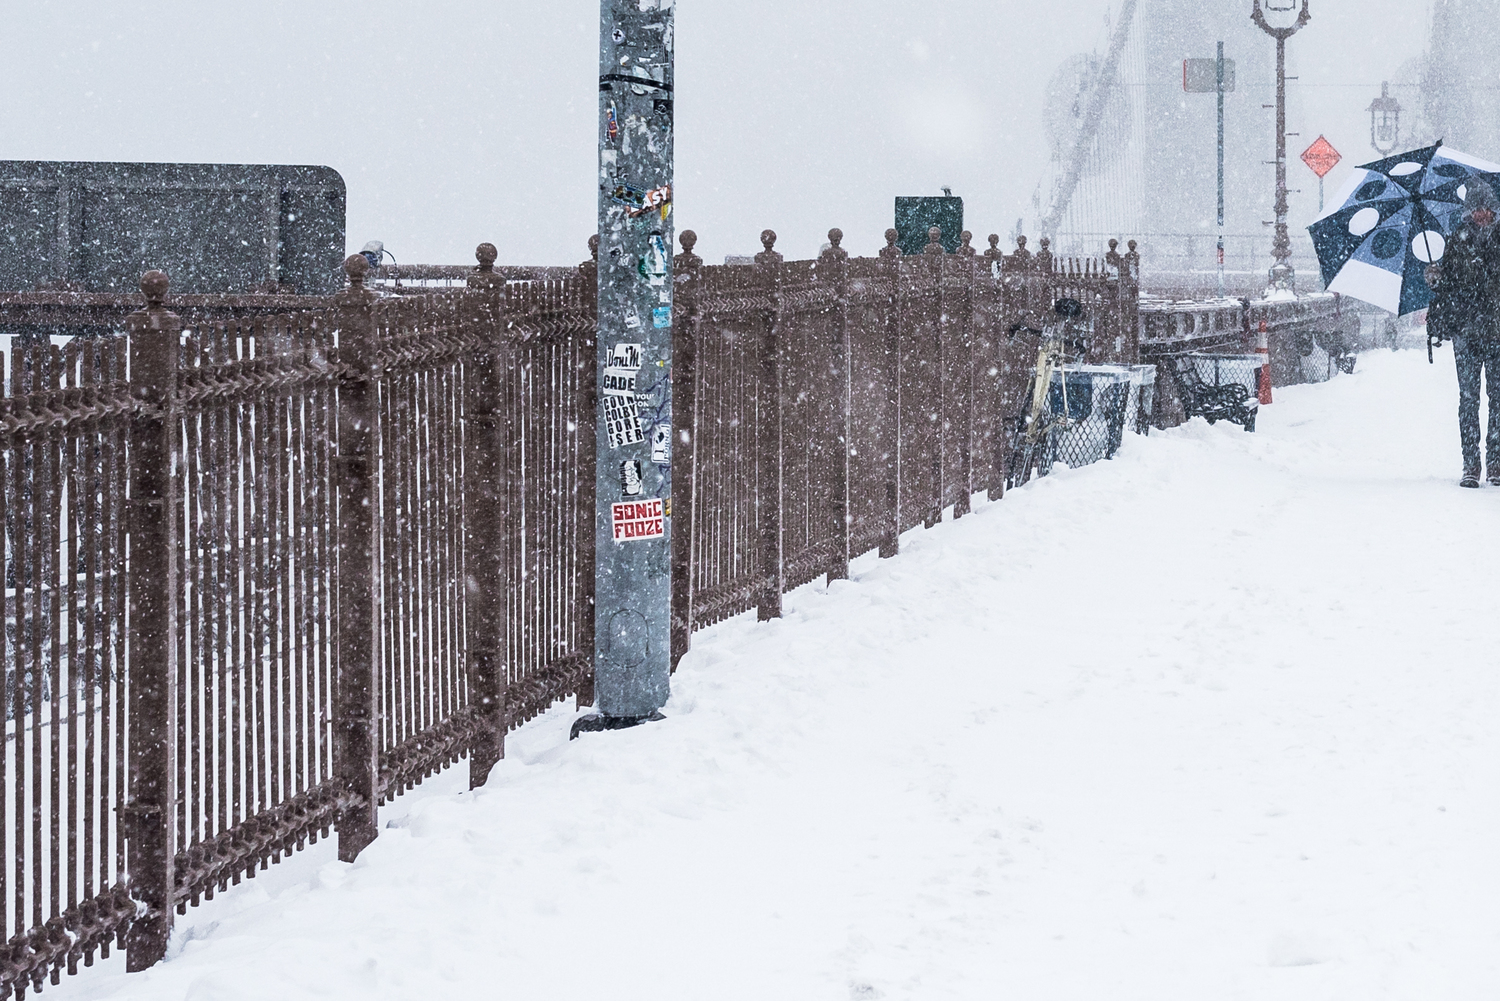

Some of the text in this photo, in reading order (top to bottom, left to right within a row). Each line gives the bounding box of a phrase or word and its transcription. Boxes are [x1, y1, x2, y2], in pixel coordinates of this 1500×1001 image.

[603, 374, 635, 392] CADE
[605, 403, 636, 422] COLBY
[614, 519, 663, 539] FOOZE
